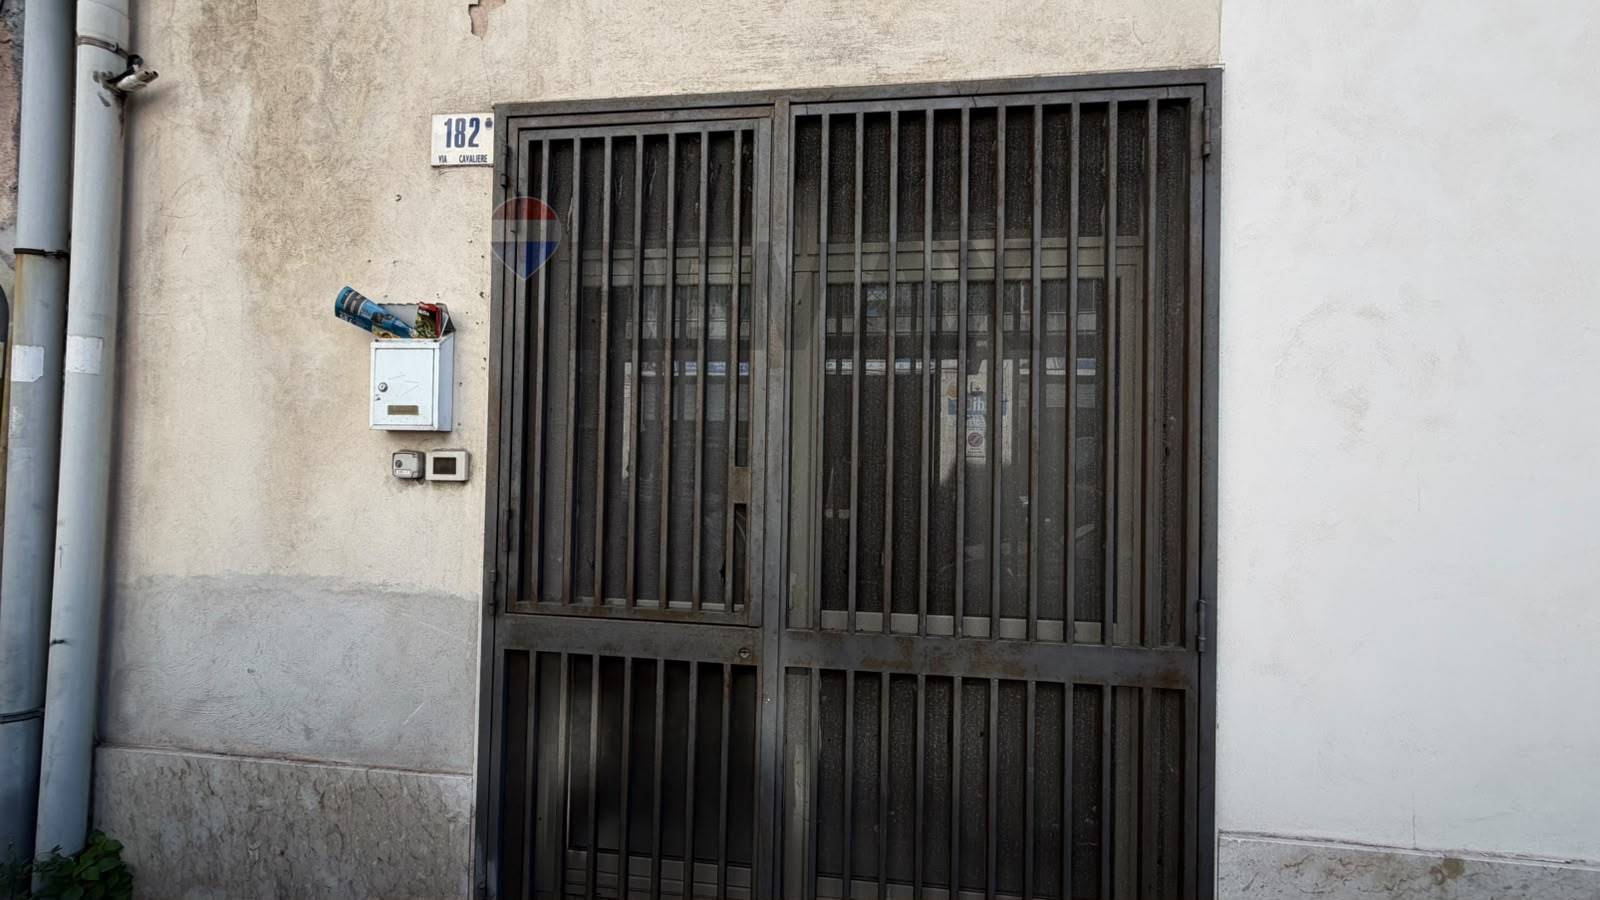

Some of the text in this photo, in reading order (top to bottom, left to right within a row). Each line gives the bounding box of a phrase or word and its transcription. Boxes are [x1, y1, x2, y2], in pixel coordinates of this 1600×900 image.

[444, 117, 480, 148] 182
[438, 154, 488, 163] VIA CAVALIERE
